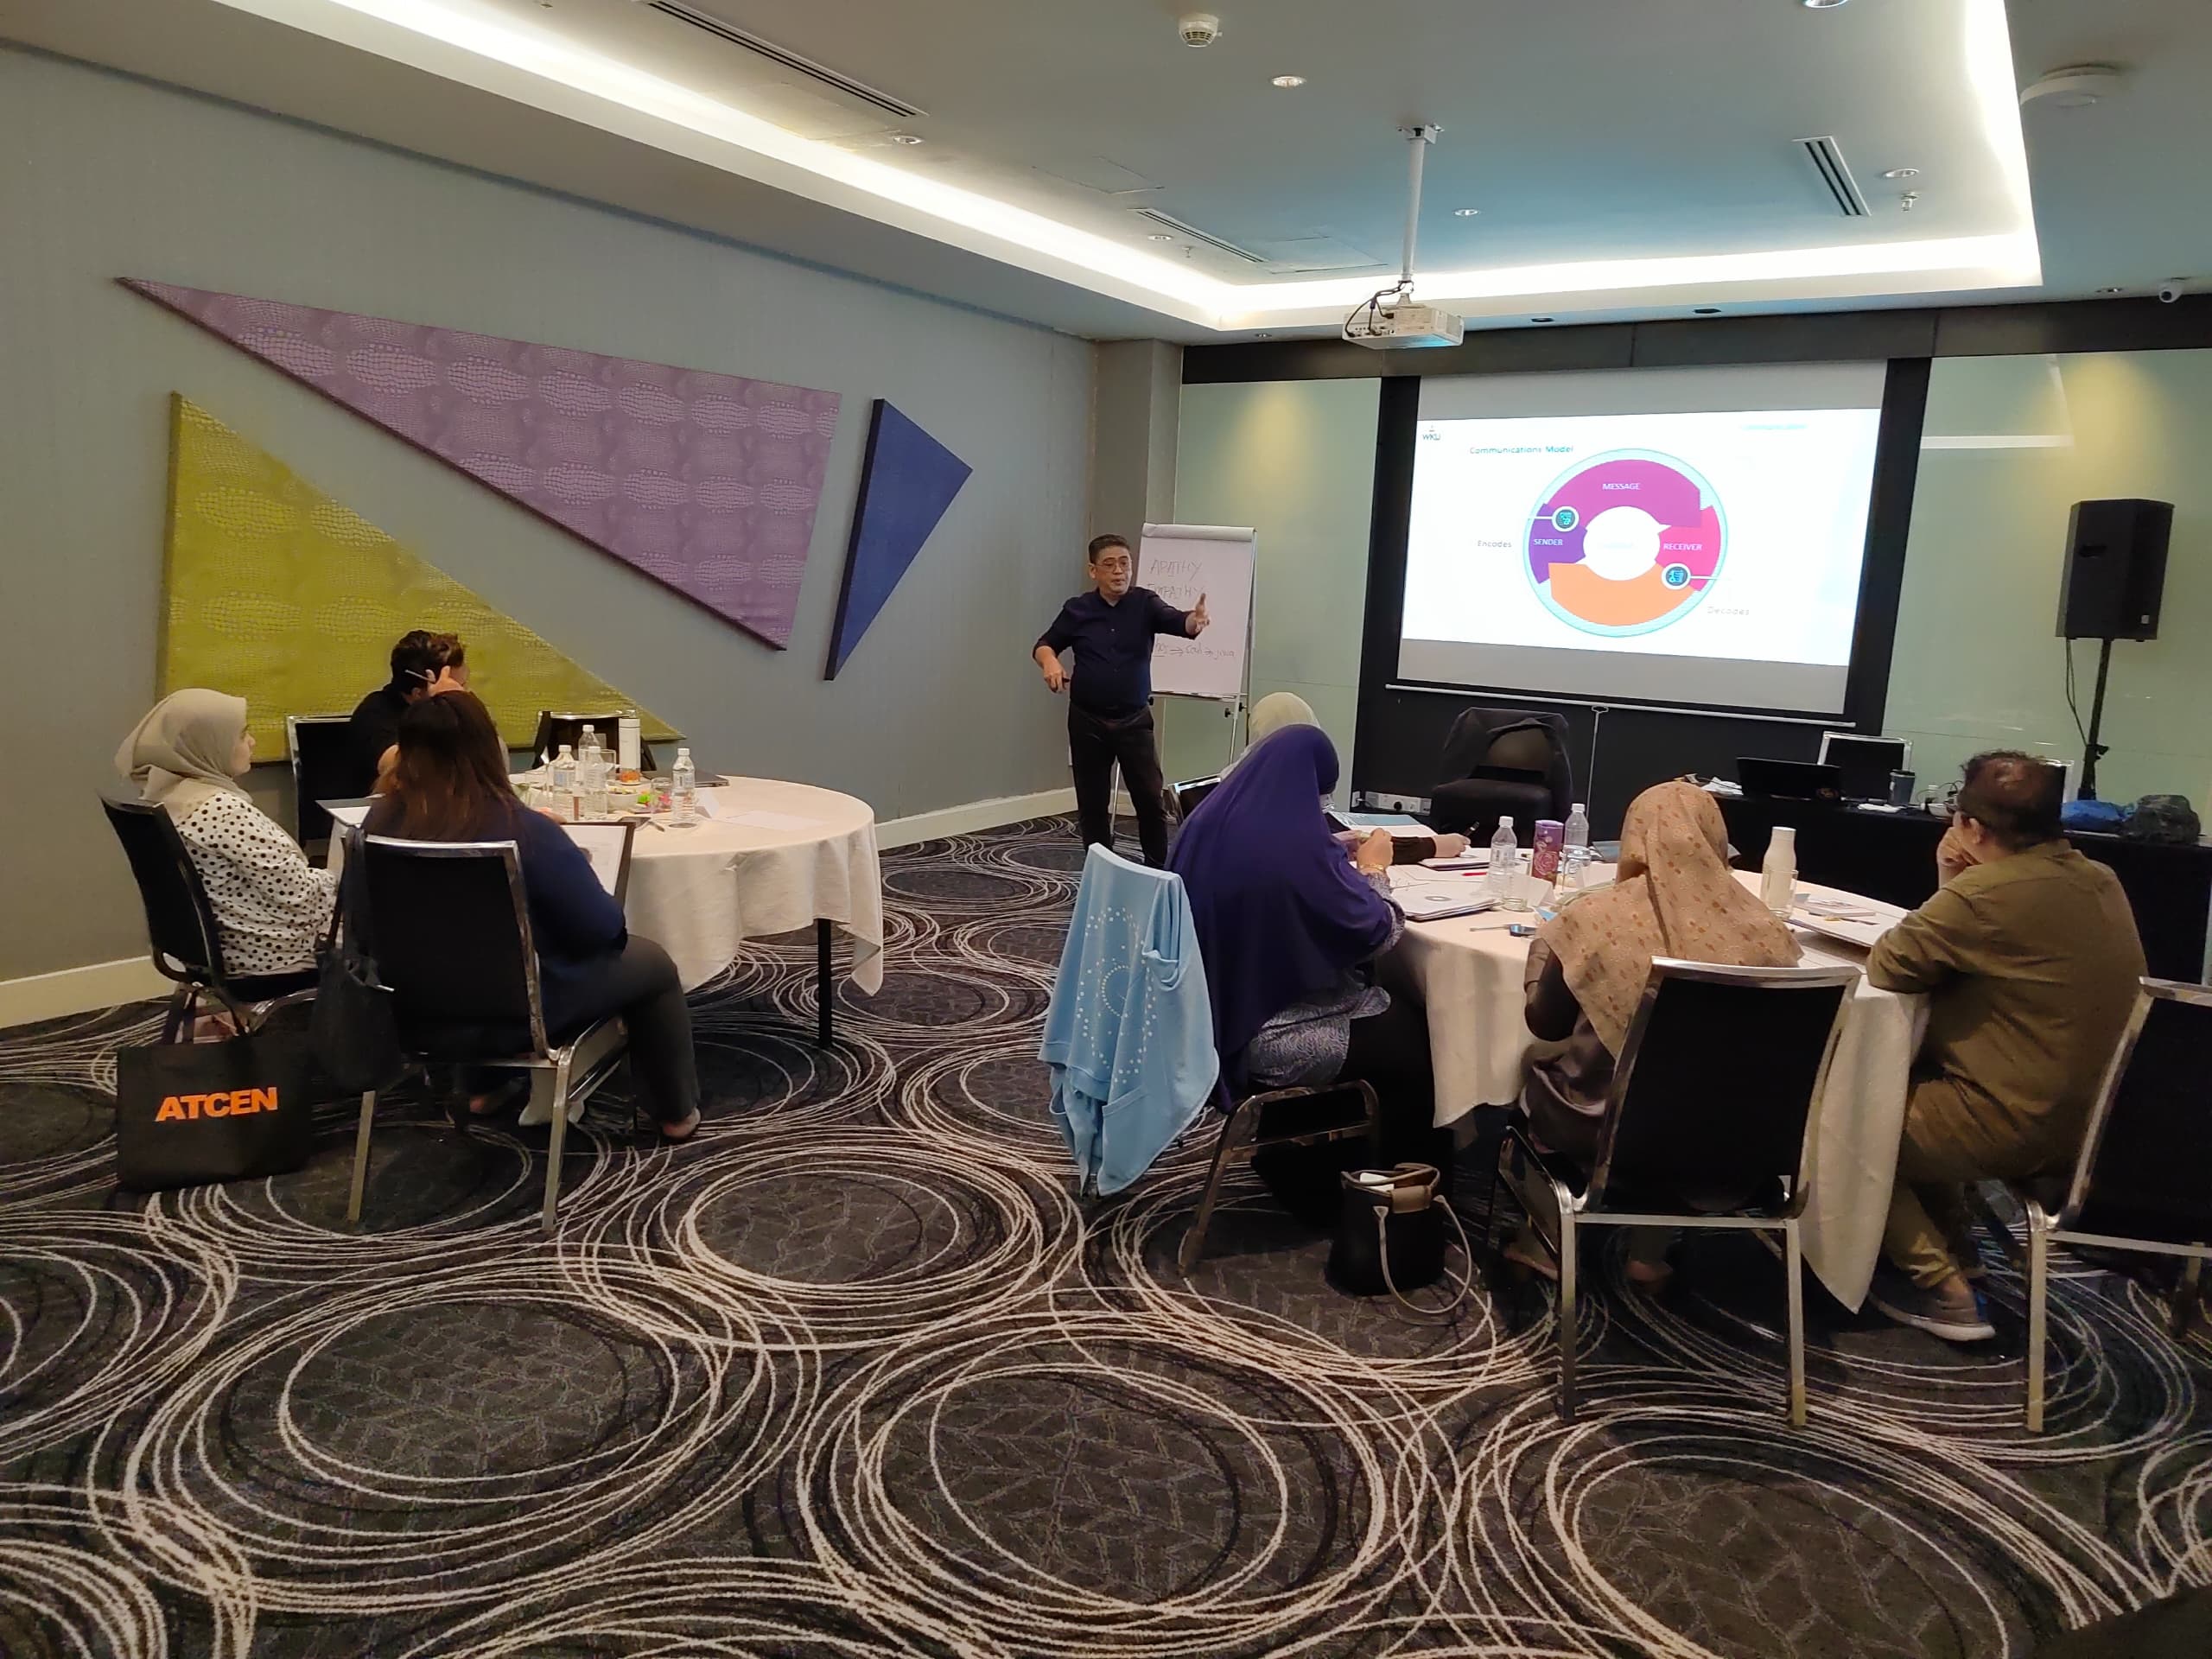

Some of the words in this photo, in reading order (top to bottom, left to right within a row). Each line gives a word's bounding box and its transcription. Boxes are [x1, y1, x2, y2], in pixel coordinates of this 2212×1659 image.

[1545, 444, 1573, 454] Model
[1602, 482, 1641, 492] MESSAGE
[1477, 540, 1512, 549] Encodes
[1662, 543, 1702, 551] RECEIVER
[1150, 559, 1202, 581] APATHY
[1707, 606, 1750, 616] Decodes
[155, 1086, 278, 1122] ATCEN
